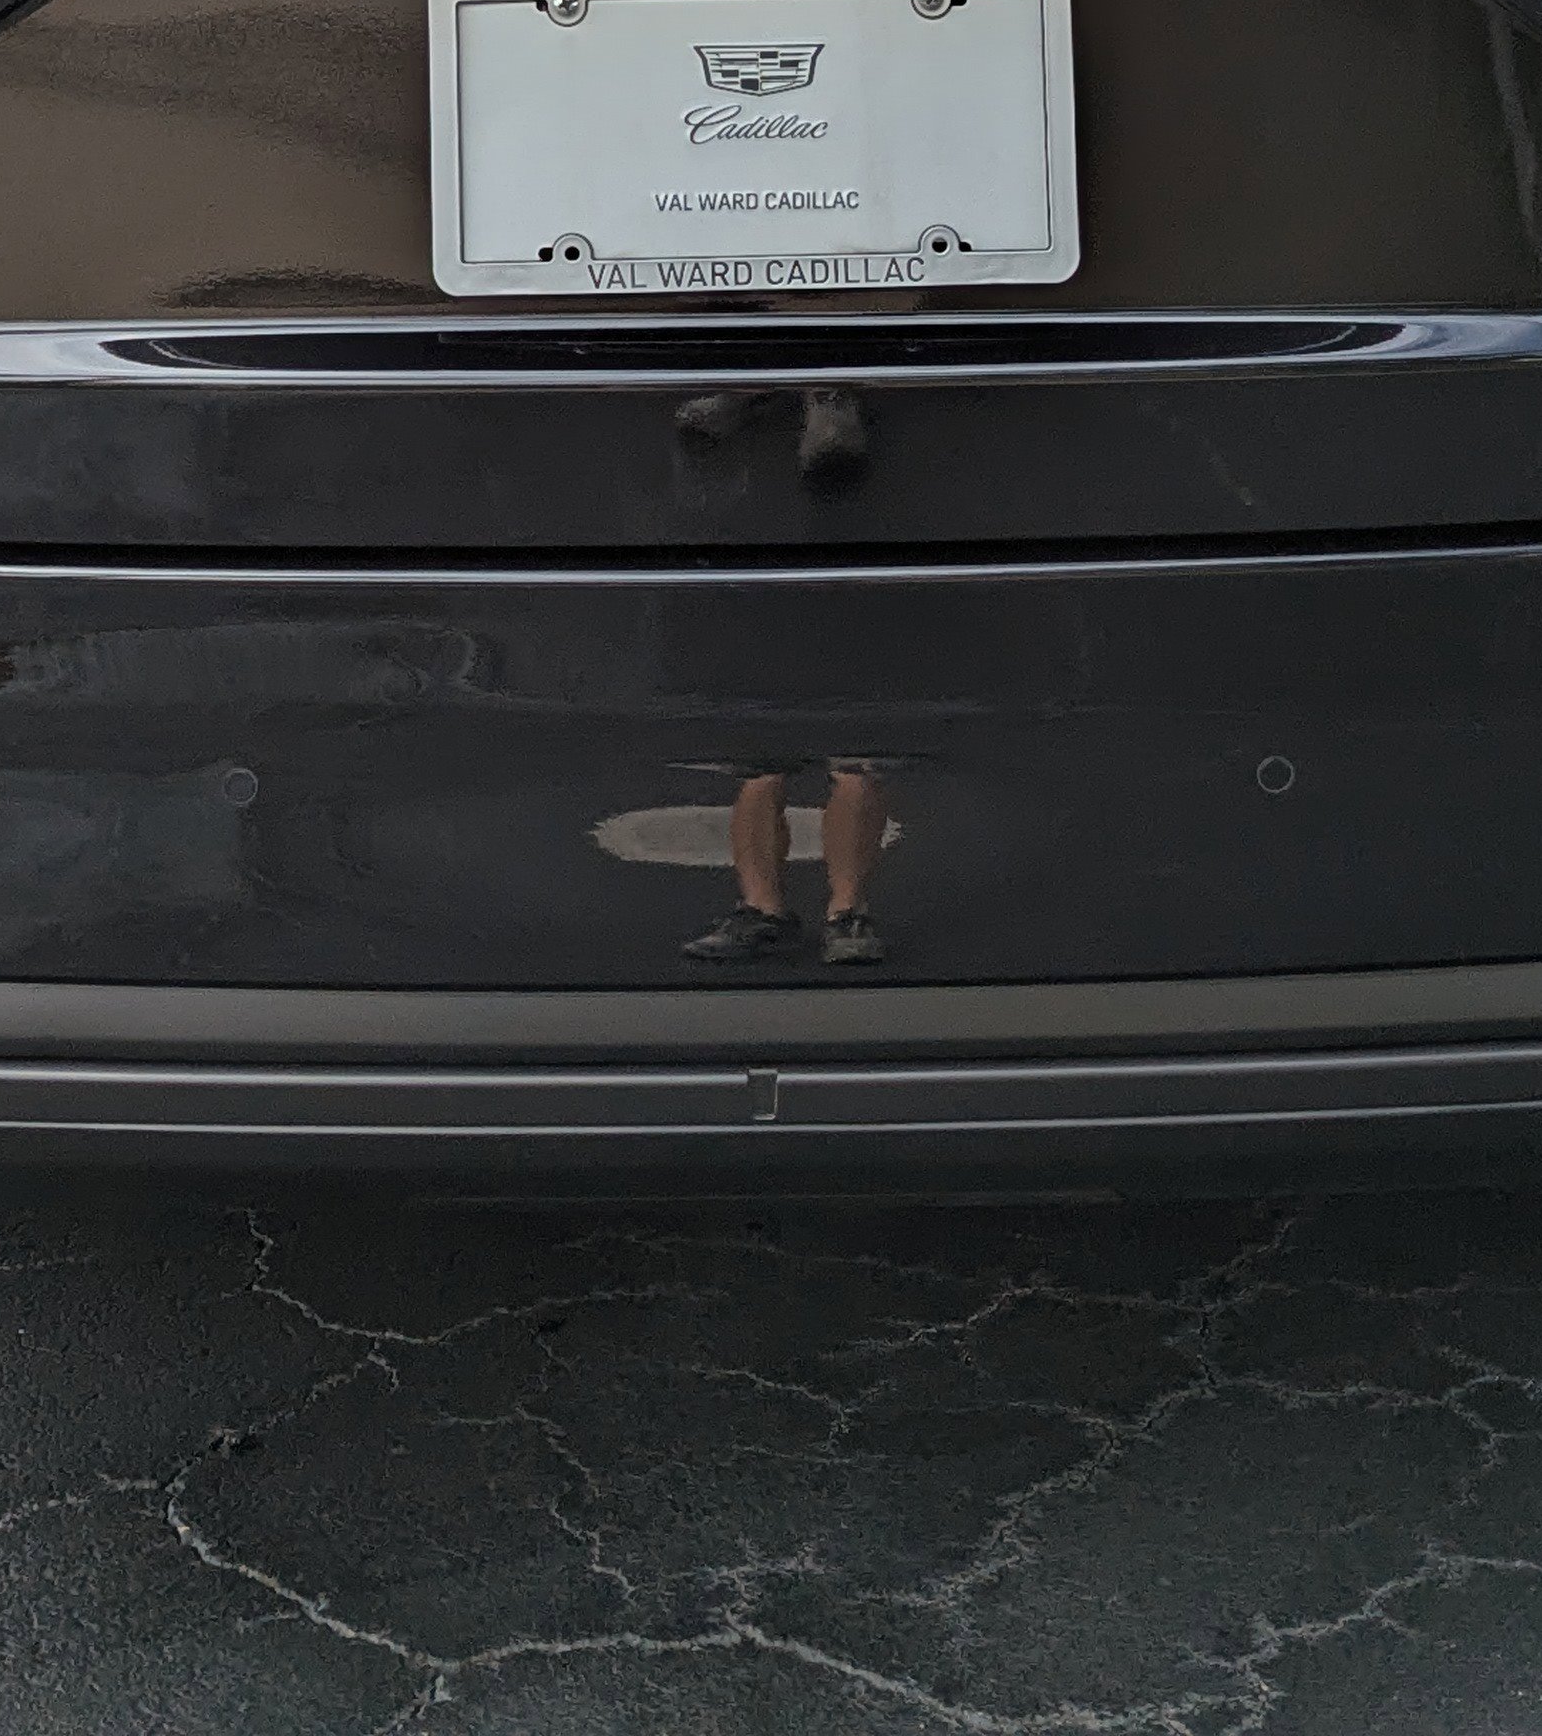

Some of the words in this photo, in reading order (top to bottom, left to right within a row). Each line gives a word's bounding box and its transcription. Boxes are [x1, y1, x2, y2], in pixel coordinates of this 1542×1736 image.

[684, 105, 828, 146] Cadillac
[655, 193, 694, 212] VAL
[698, 192, 759, 211] WARD
[765, 191, 860, 210] CADILLAC
[587, 263, 648, 291] VAL
[658, 261, 755, 290] WARD
[765, 256, 926, 287] CADILLAC
